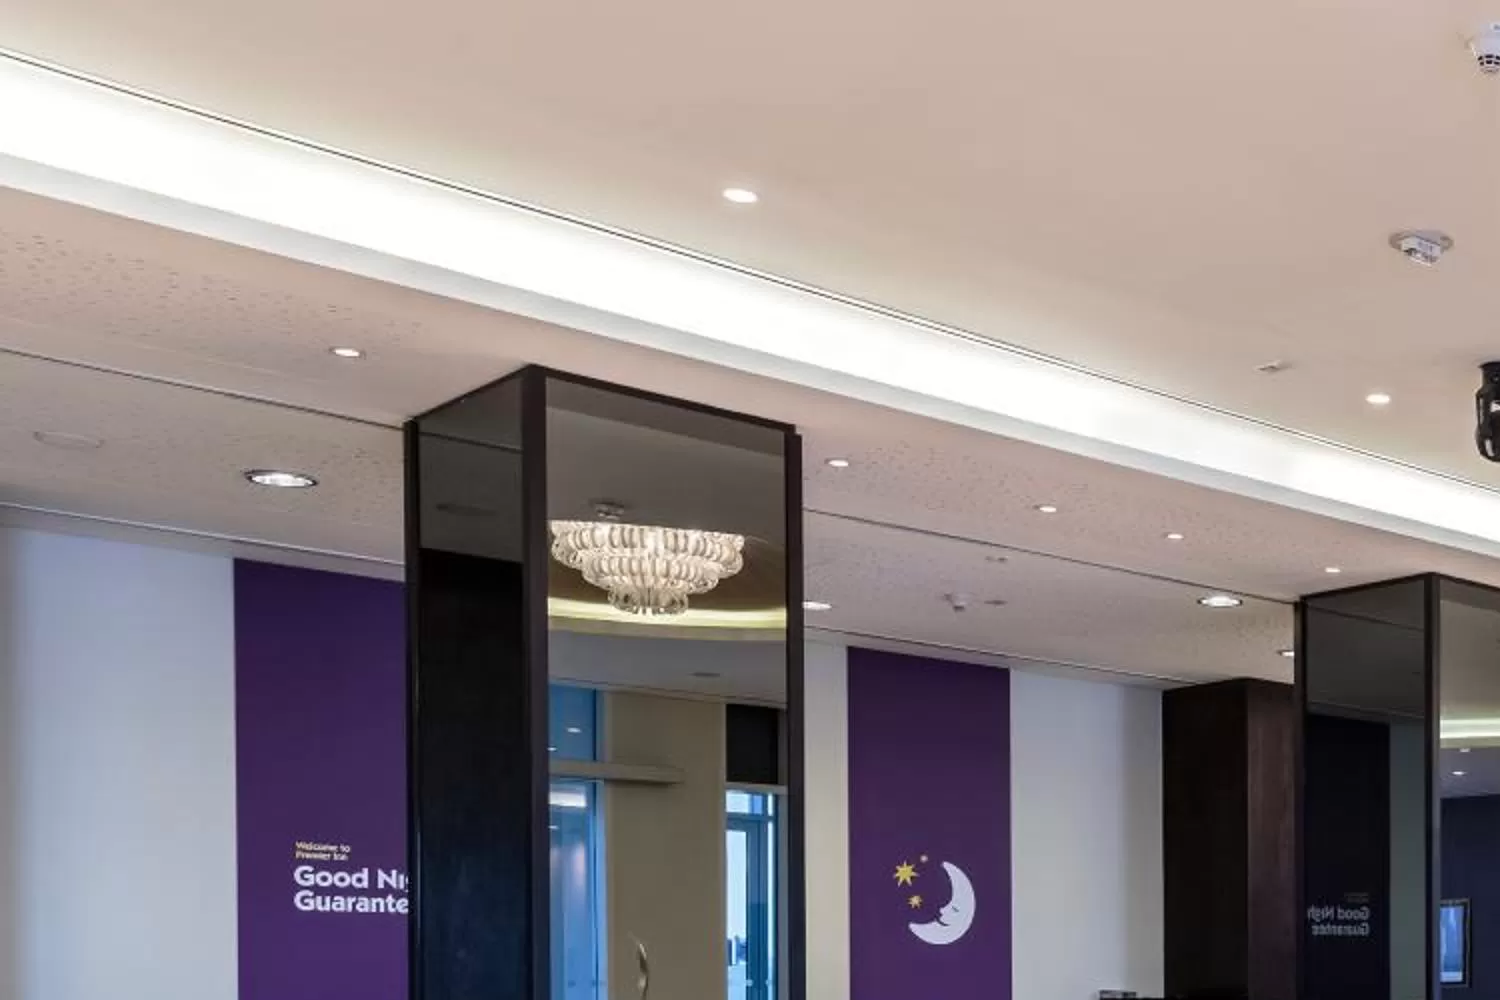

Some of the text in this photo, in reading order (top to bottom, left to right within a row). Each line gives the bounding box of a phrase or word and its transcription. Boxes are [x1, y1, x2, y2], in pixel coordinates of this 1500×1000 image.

[340, 843, 351, 853] to
[293, 865, 369, 888] Good
[293, 889, 409, 914] Guarante
